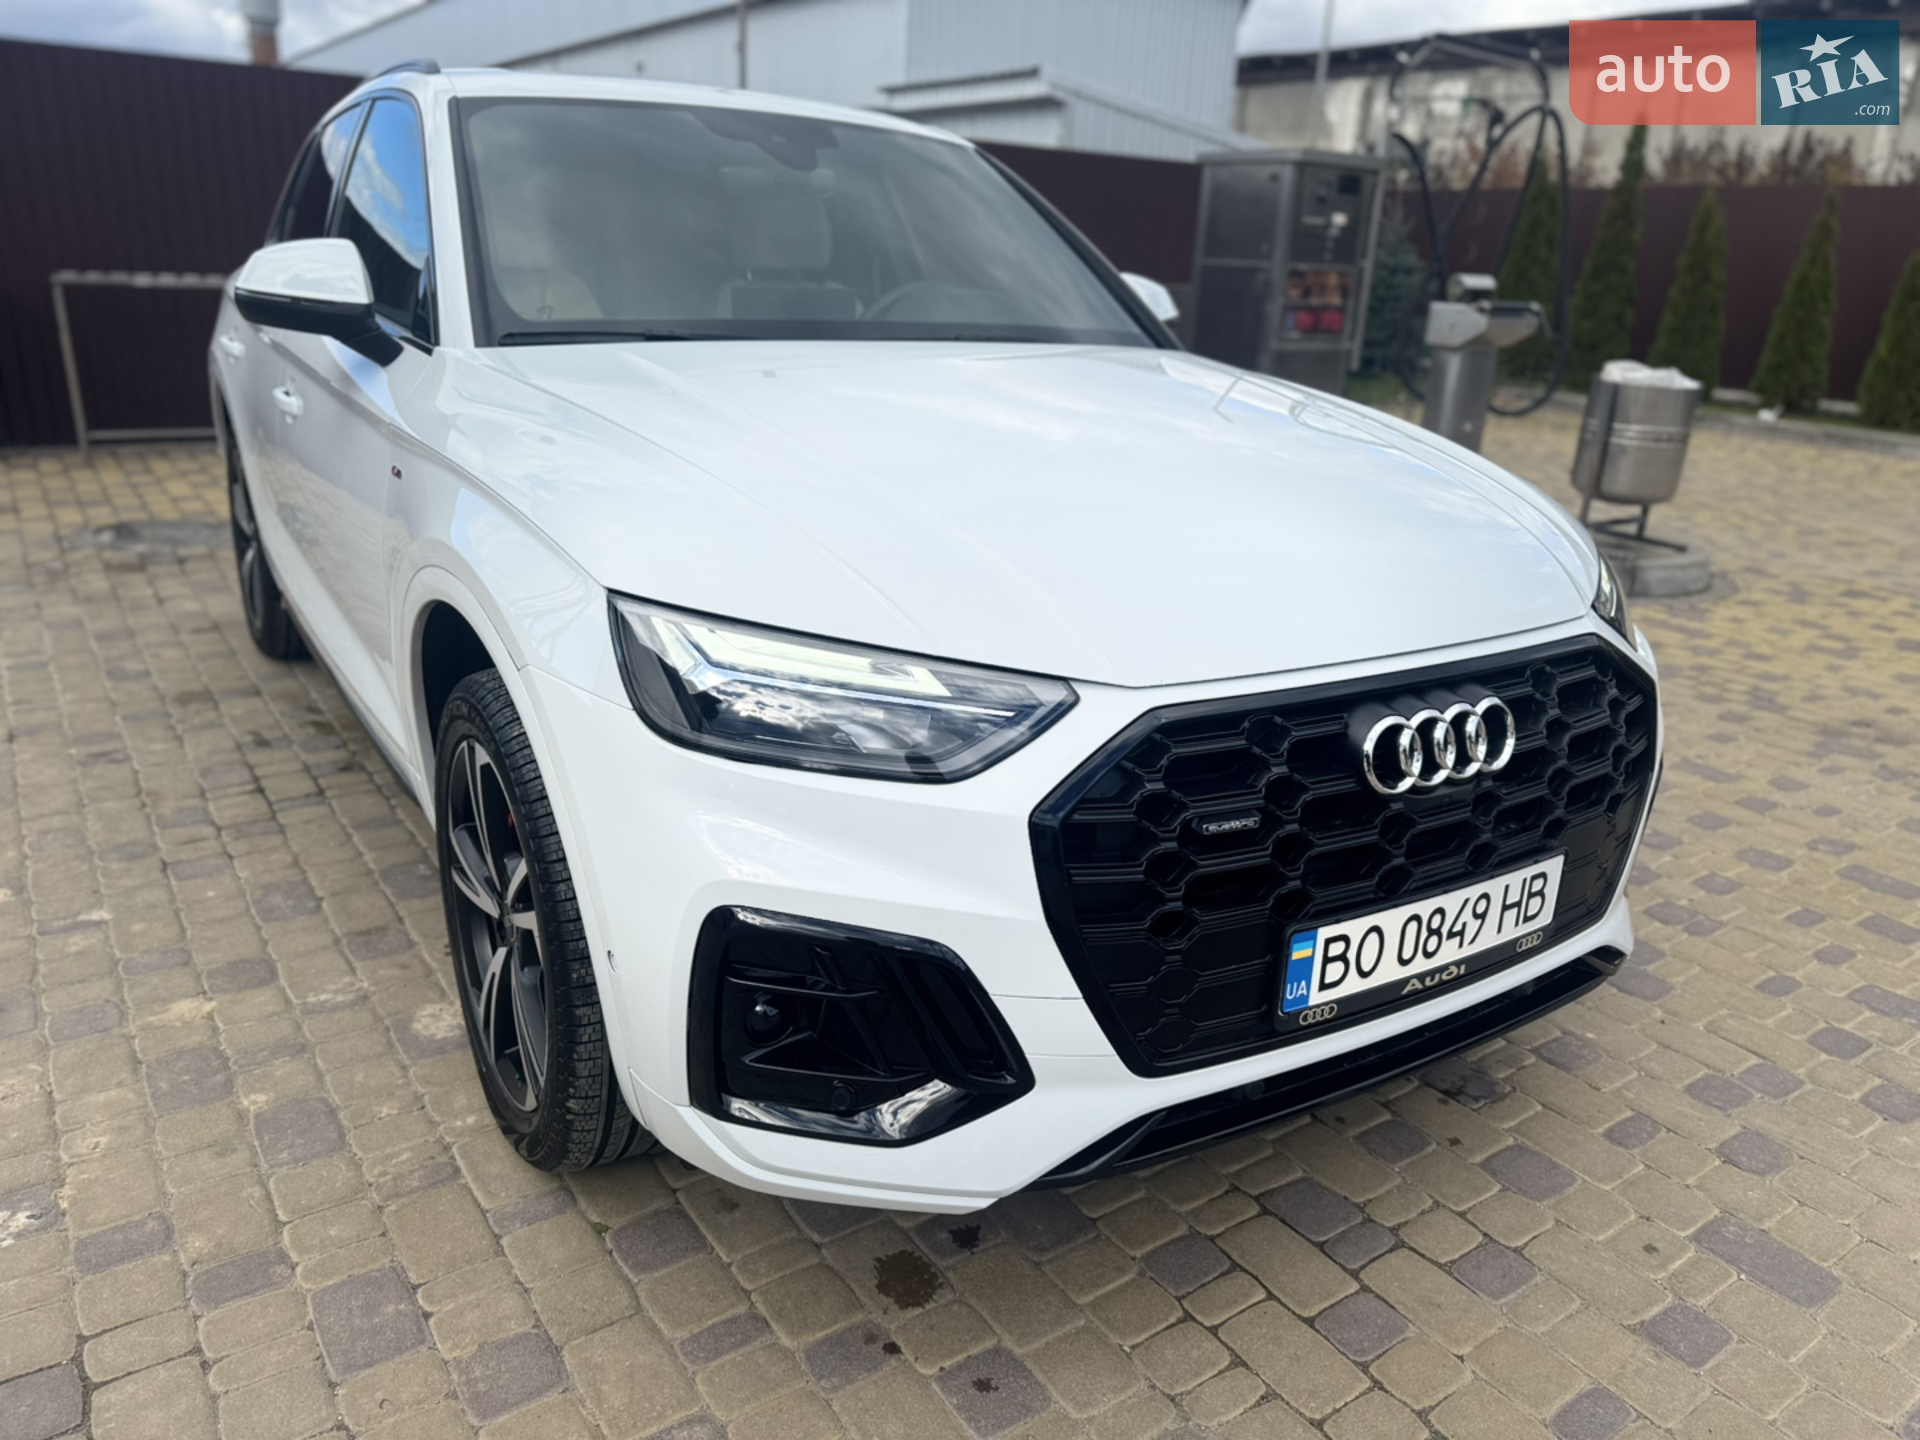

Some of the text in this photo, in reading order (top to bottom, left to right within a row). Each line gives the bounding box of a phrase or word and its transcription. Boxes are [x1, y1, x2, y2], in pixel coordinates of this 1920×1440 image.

[1317, 871, 1548, 993] BO 0849 HB
[1286, 979, 1308, 1000] UA
[1400, 964, 1467, 996] Audi
